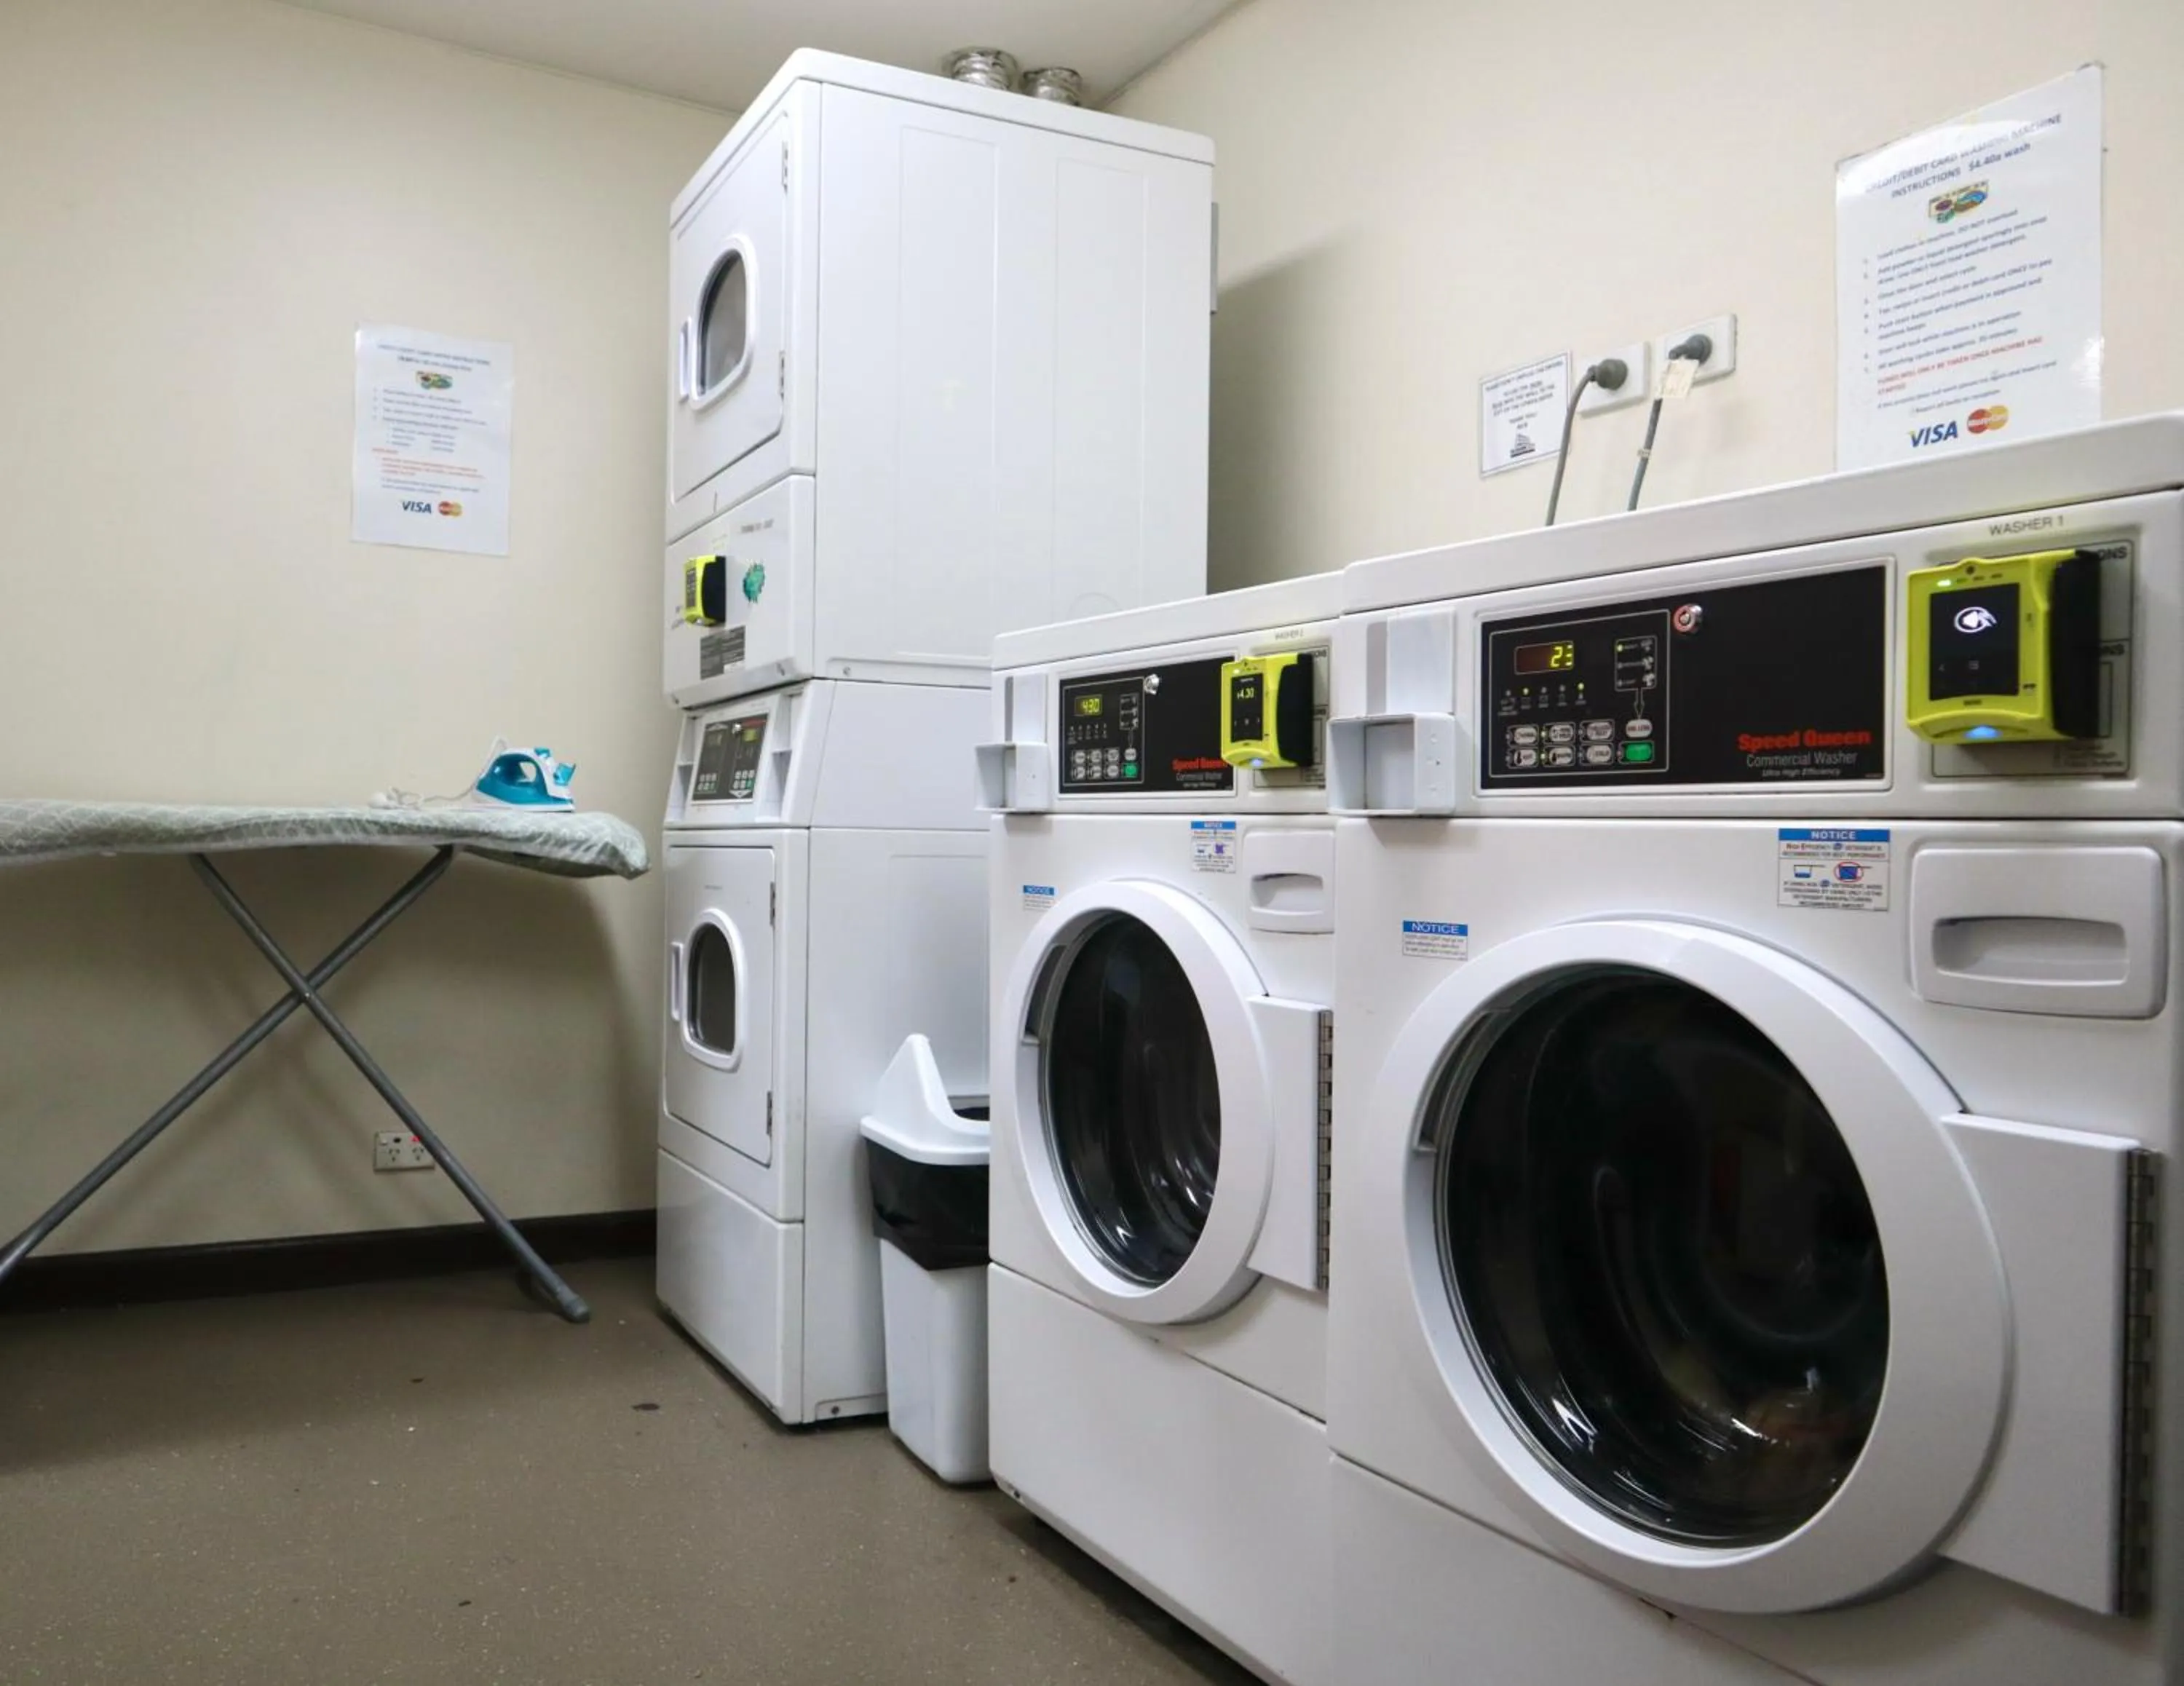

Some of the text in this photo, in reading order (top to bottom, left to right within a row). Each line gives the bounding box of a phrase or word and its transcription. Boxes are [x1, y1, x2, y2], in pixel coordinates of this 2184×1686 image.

[1891, 167, 1961, 199] INSTRUCTIONS
[2003, 143, 2031, 158] wash
[1910, 421, 1958, 447] VISA
[402, 500, 432, 514] VISA
[1989, 515, 2064, 536] WASHER 1
[1738, 729, 1871, 753] Speed Queen
[1747, 751, 1857, 767] Commercial Washer
[1811, 831, 1856, 839] NOTICE
[1412, 922, 1459, 934] NOTICE
